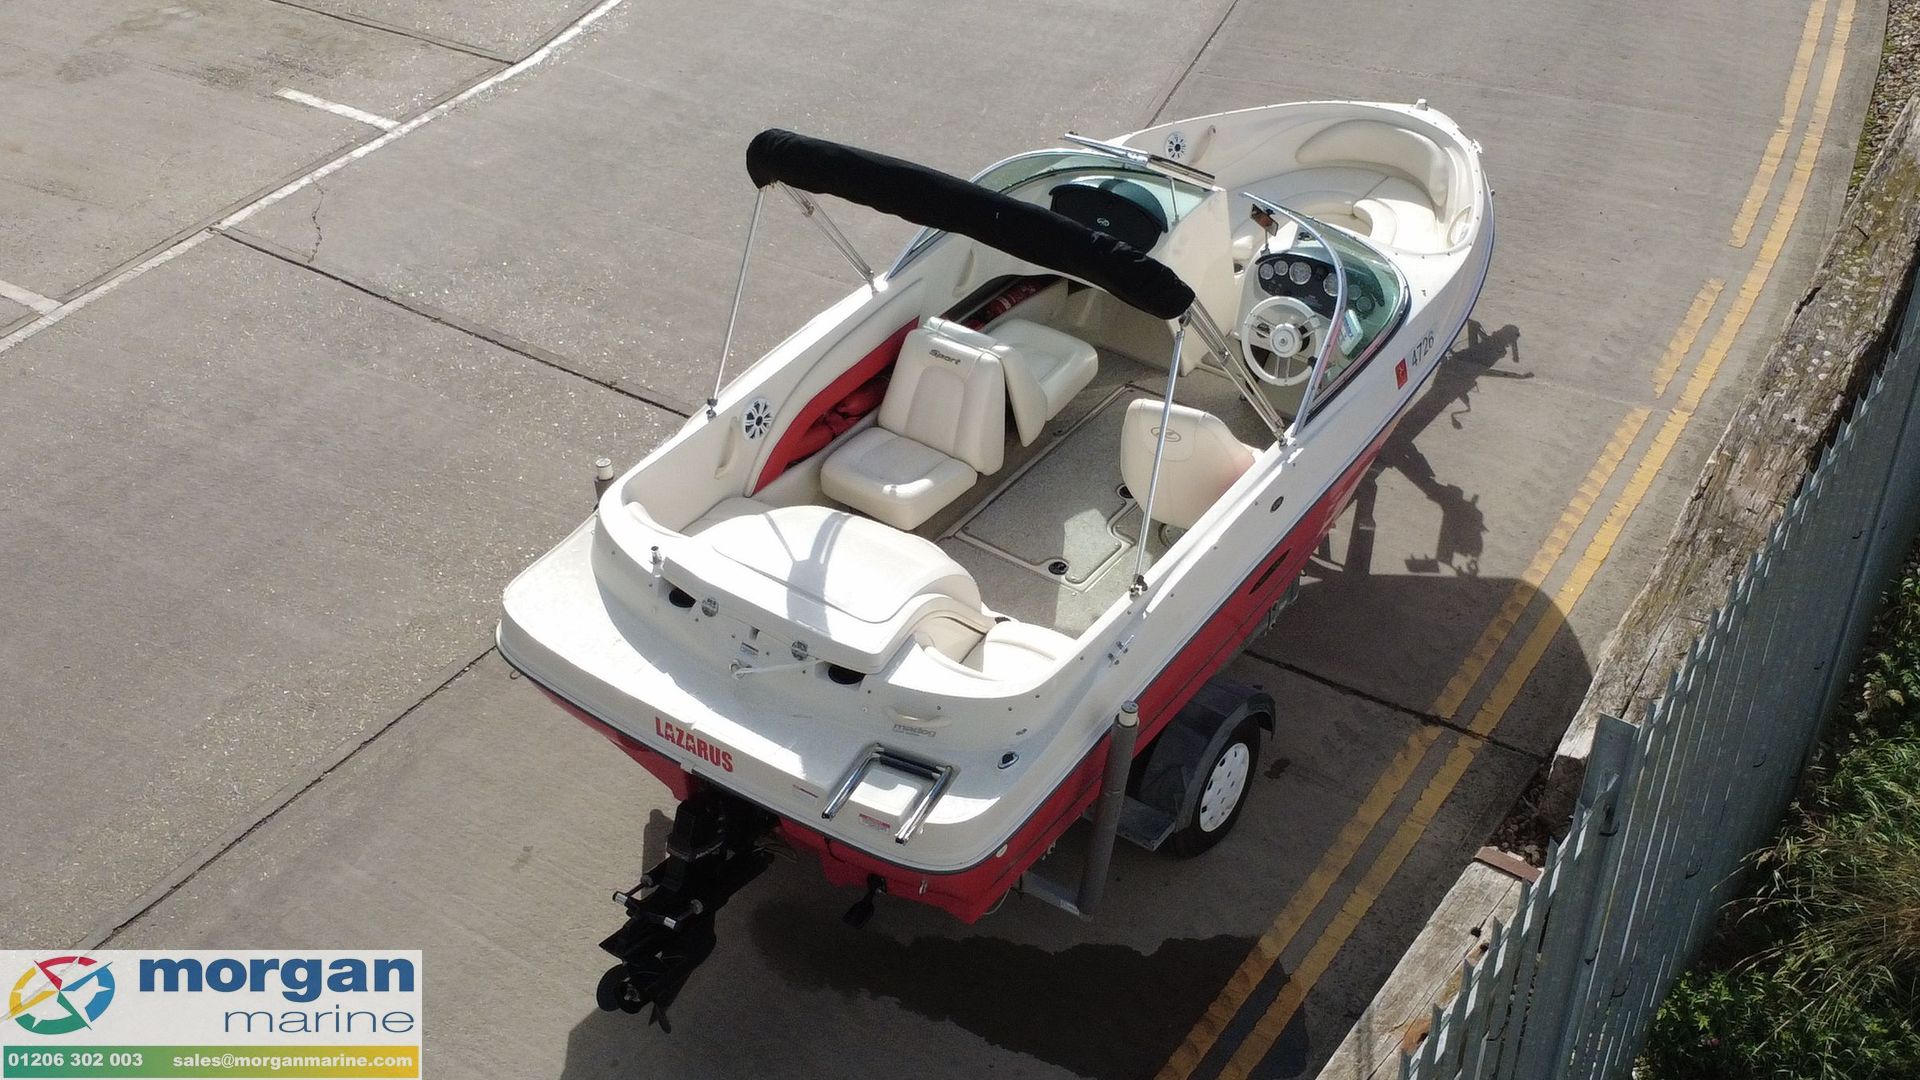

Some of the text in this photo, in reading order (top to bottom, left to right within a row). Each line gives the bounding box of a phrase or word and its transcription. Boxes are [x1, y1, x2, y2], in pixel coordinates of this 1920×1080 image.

[929, 349, 961, 364] Sport
[1412, 331, 1435, 367] 4726
[655, 717, 733, 772] LAZARUS
